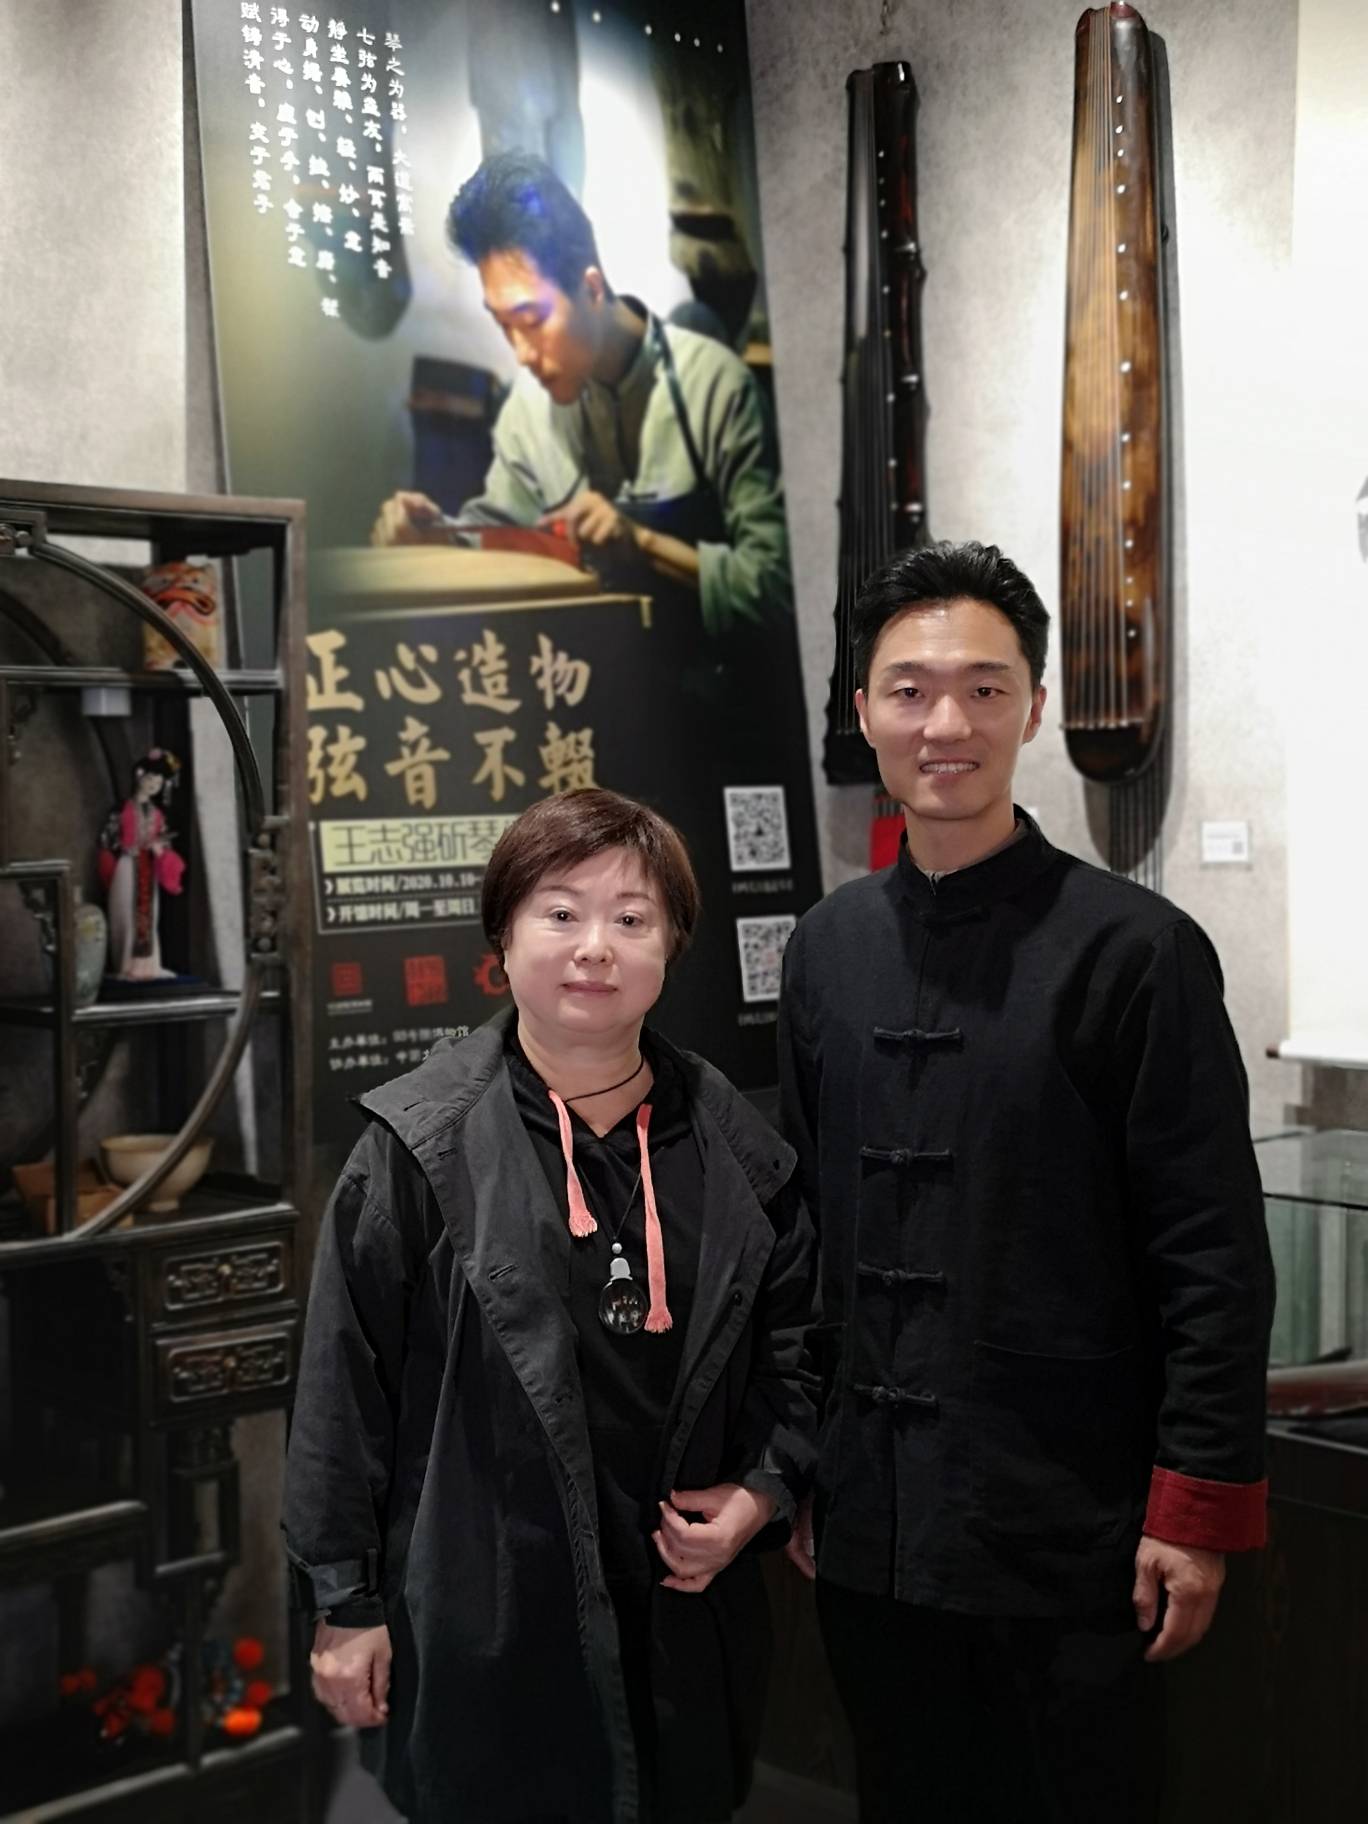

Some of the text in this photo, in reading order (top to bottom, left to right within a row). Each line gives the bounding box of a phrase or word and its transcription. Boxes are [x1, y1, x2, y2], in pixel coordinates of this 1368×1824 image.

[305, 628, 591, 714] 正心造物
[331, 820, 512, 866] 王志强斫琴
